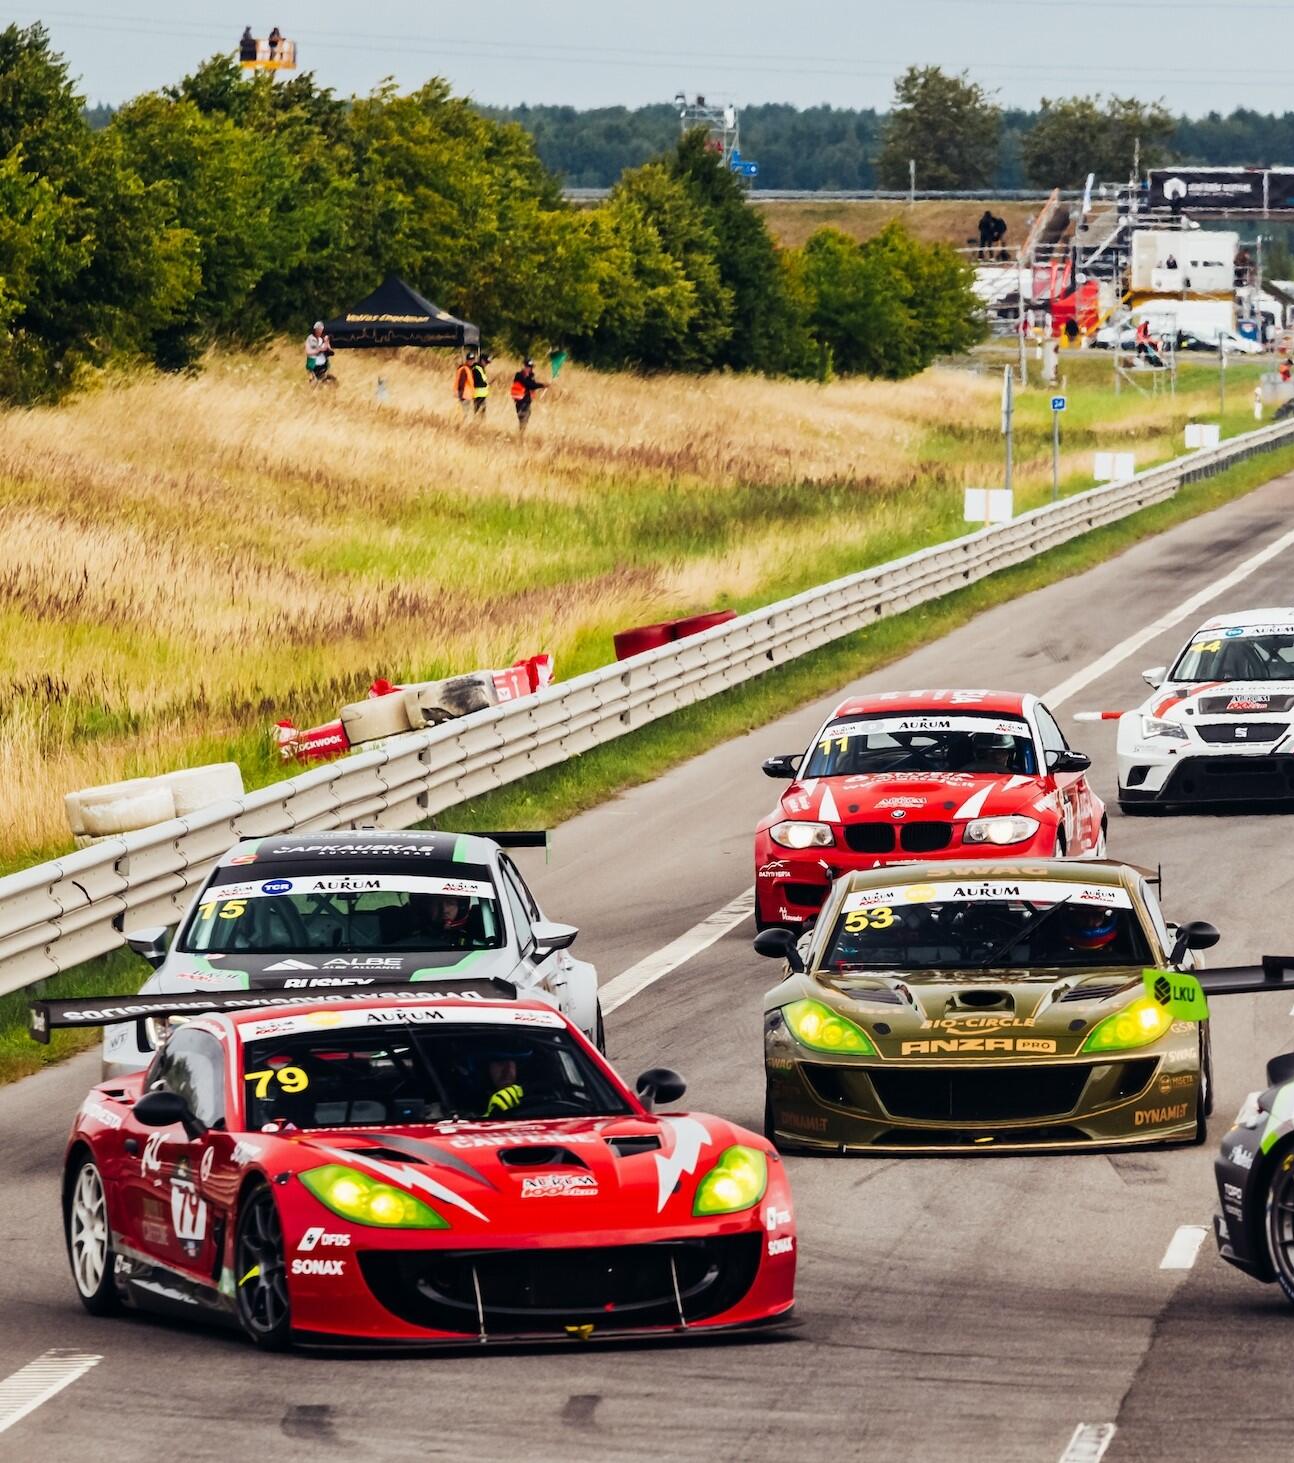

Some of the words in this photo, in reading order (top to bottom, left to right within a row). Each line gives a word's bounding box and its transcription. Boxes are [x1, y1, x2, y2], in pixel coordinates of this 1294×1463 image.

[1232, 694, 1271, 702] AURUM
[899, 720, 951, 731] AURUM
[818, 736, 850, 757] 11
[926, 866, 1049, 877] SWAG
[264, 882, 292, 891] TCR
[313, 879, 381, 890] AURUM
[445, 882, 479, 890] AURUM
[953, 885, 1021, 897] AURUM
[861, 892, 894, 901] AURUM
[1082, 890, 1116, 898] AURUM
[198, 899, 249, 920] 15
[844, 907, 895, 932] 53
[323, 957, 404, 966] ALBE
[1173, 985, 1197, 1003] LKU
[366, 1010, 445, 1025] AURUM
[920, 1016, 1036, 1030] BIO-CIRCLE
[1170, 1021, 1196, 1034] GSR
[901, 1038, 1014, 1055] ANZA
[1021, 1041, 1051, 1050] PRO
[1167, 1047, 1198, 1062] SWAG
[244, 1066, 309, 1098] 79
[450, 1133, 597, 1149] CAFFEINE
[524, 1175, 595, 1189] AURUM
[320, 1233, 352, 1247] DFDS
[291, 1258, 346, 1275] SONAX
